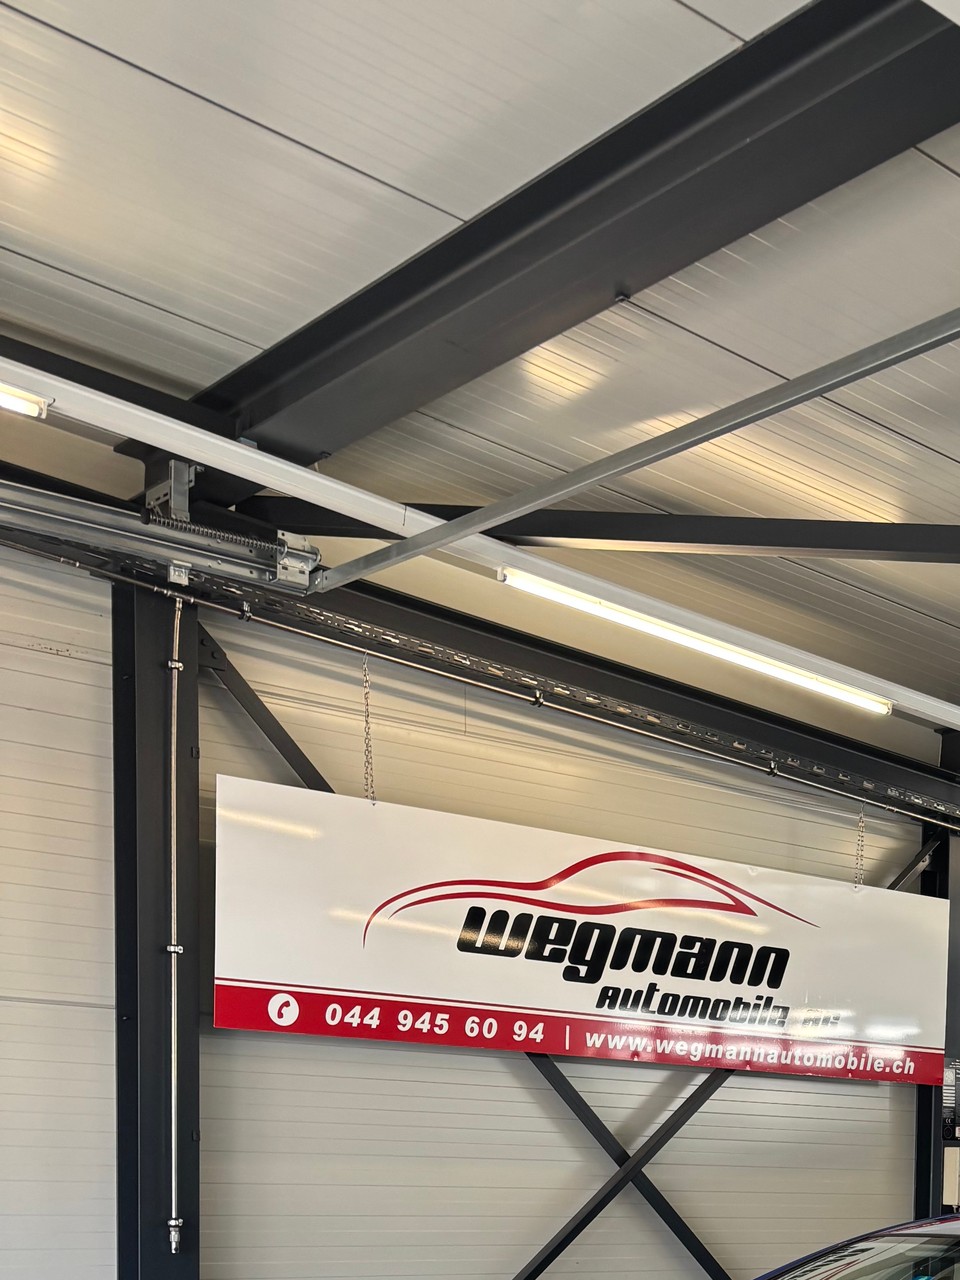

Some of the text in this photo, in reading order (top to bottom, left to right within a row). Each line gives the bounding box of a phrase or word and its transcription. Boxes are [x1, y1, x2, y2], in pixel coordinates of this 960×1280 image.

[457, 905, 790, 989] wegmann
[325, 1003, 915, 1075] 044 945 60 94 www.wegmannautomobile.ch
